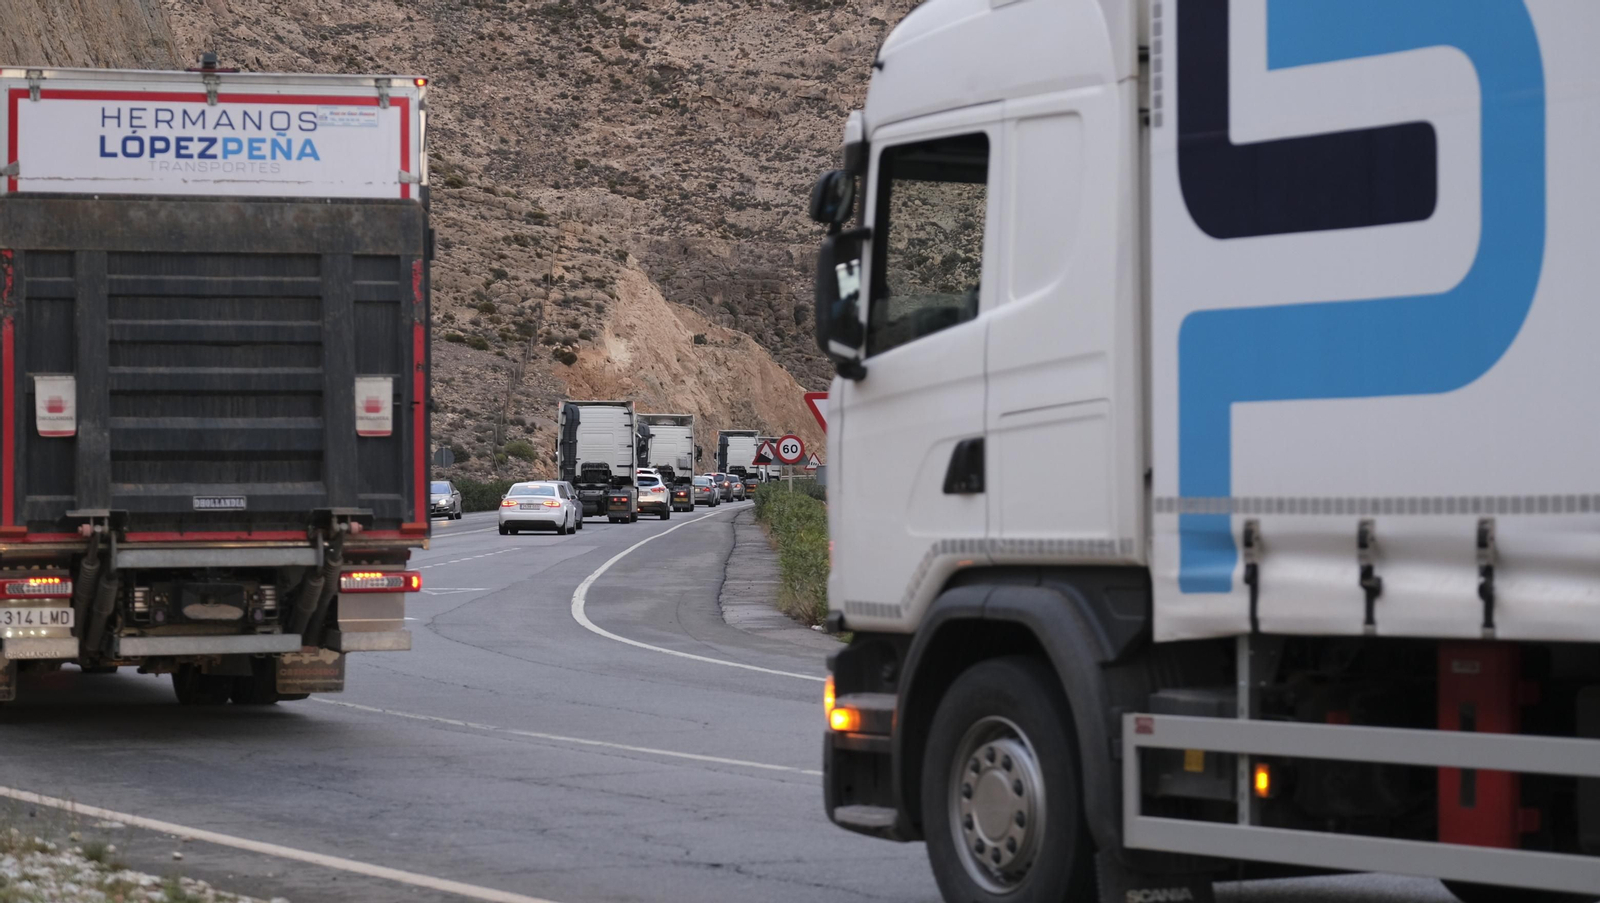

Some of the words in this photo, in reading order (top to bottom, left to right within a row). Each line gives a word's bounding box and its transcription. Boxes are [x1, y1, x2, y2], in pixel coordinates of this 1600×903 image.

[101, 106, 318, 132] HERMANOS
[99, 130, 321, 162] LÓPEZPEÑA
[148, 160, 281, 174] TRANSPORTES
[782, 444, 798, 454] 60
[194, 498, 245, 508] DHOLLANDIA
[0, 610, 33, 625] 314
[40, 610, 70, 625] LMD
[1125, 886, 1194, 903] SCANIA
